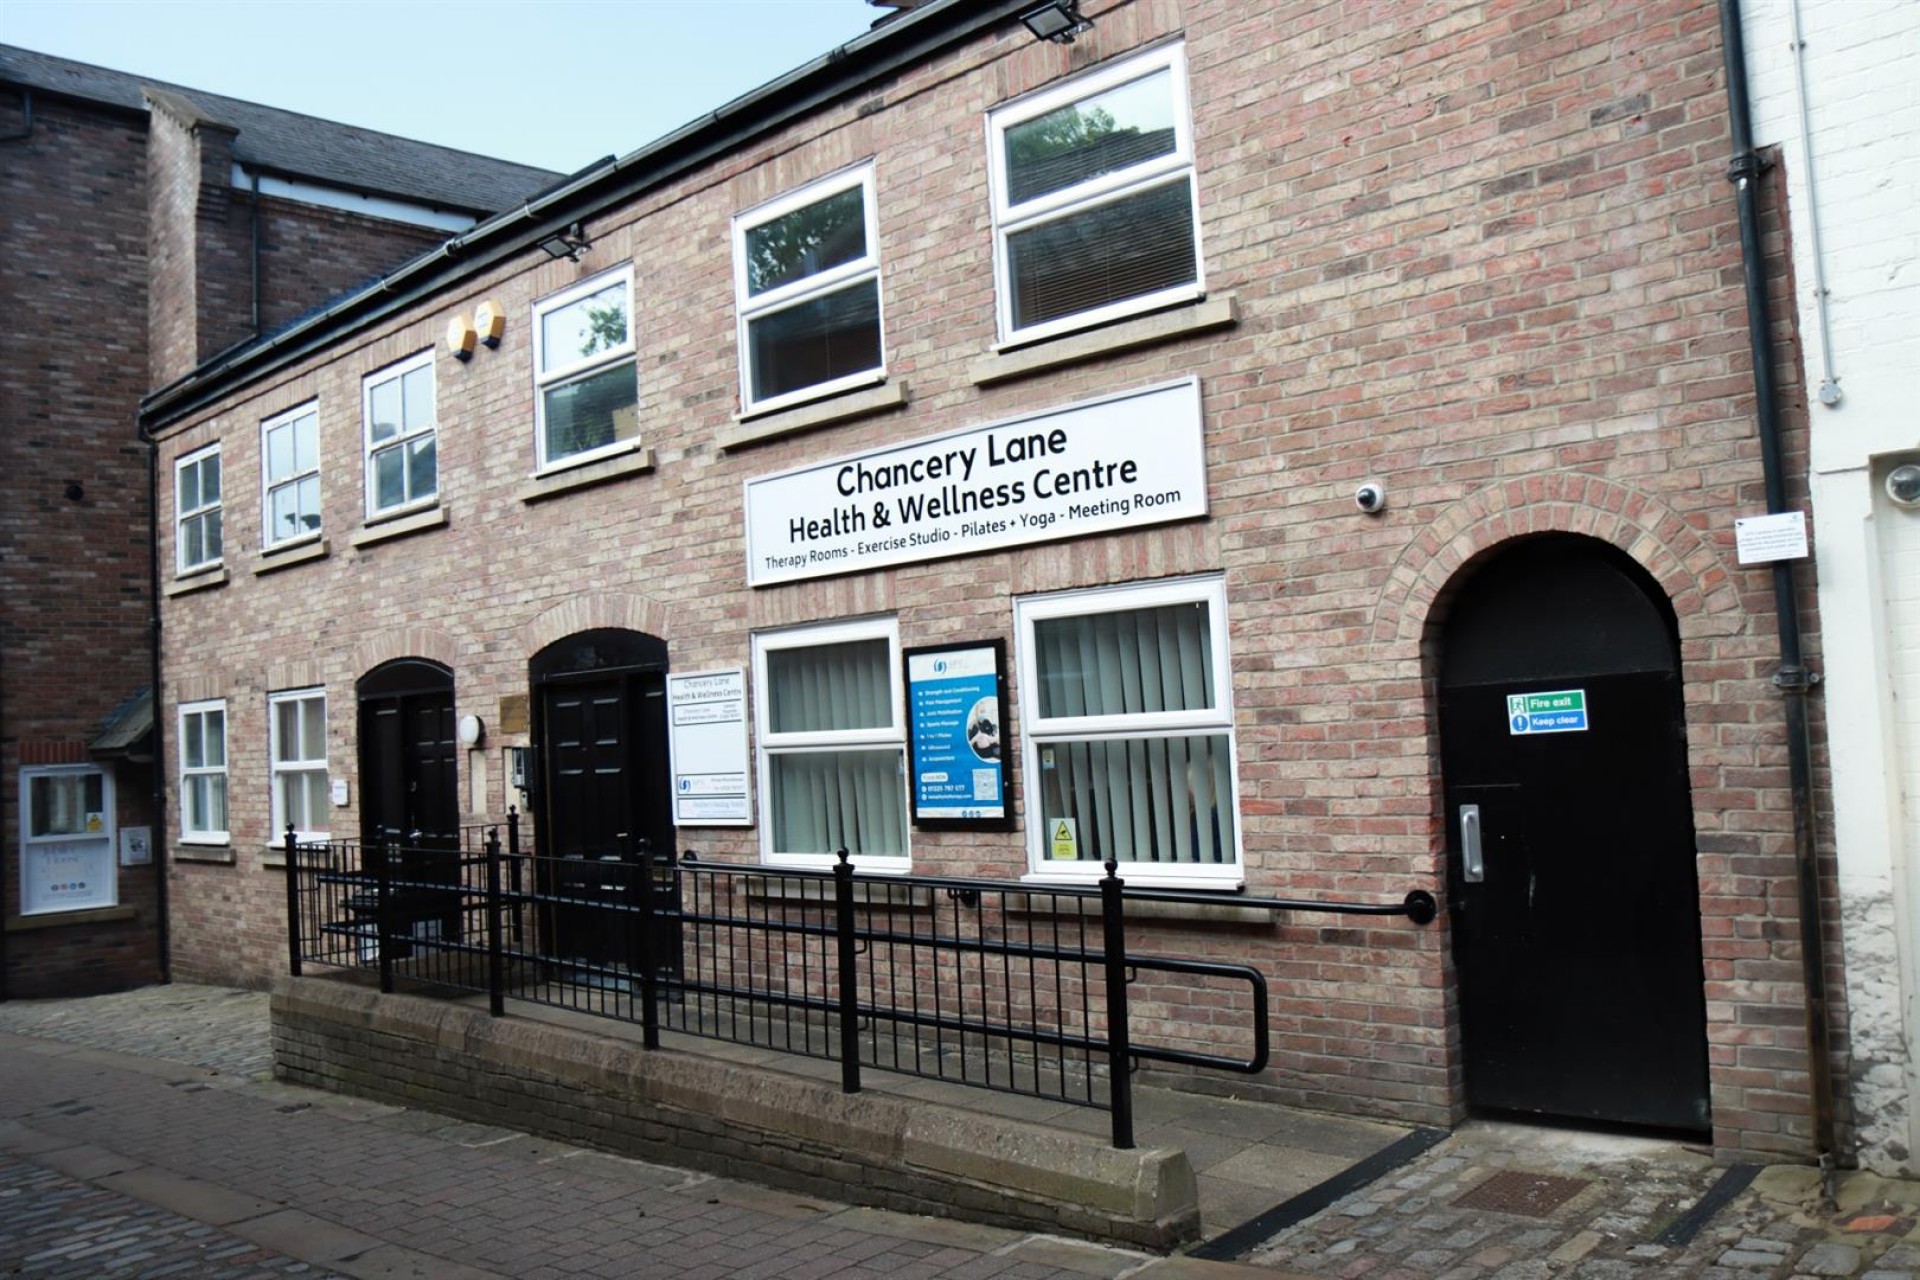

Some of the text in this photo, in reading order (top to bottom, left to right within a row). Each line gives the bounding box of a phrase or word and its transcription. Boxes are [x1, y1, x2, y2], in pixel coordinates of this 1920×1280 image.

[836, 428, 1068, 498] Chancery Lane
[765, 554, 808, 570] Therapy
[809, 547, 848, 563] Rooms
[857, 534, 907, 555] Exercise
[909, 529, 951, 547] Studio
[961, 519, 1006, 538] Pilates
[1019, 513, 1056, 529] Yoga
[1068, 498, 1130, 520] Meeting
[1133, 490, 1182, 509] Room
[789, 457, 1138, 544] Health & Wellness Centre
[1530, 697, 1572, 709] Fire exit
[1532, 715, 1579, 728] Keep clear
